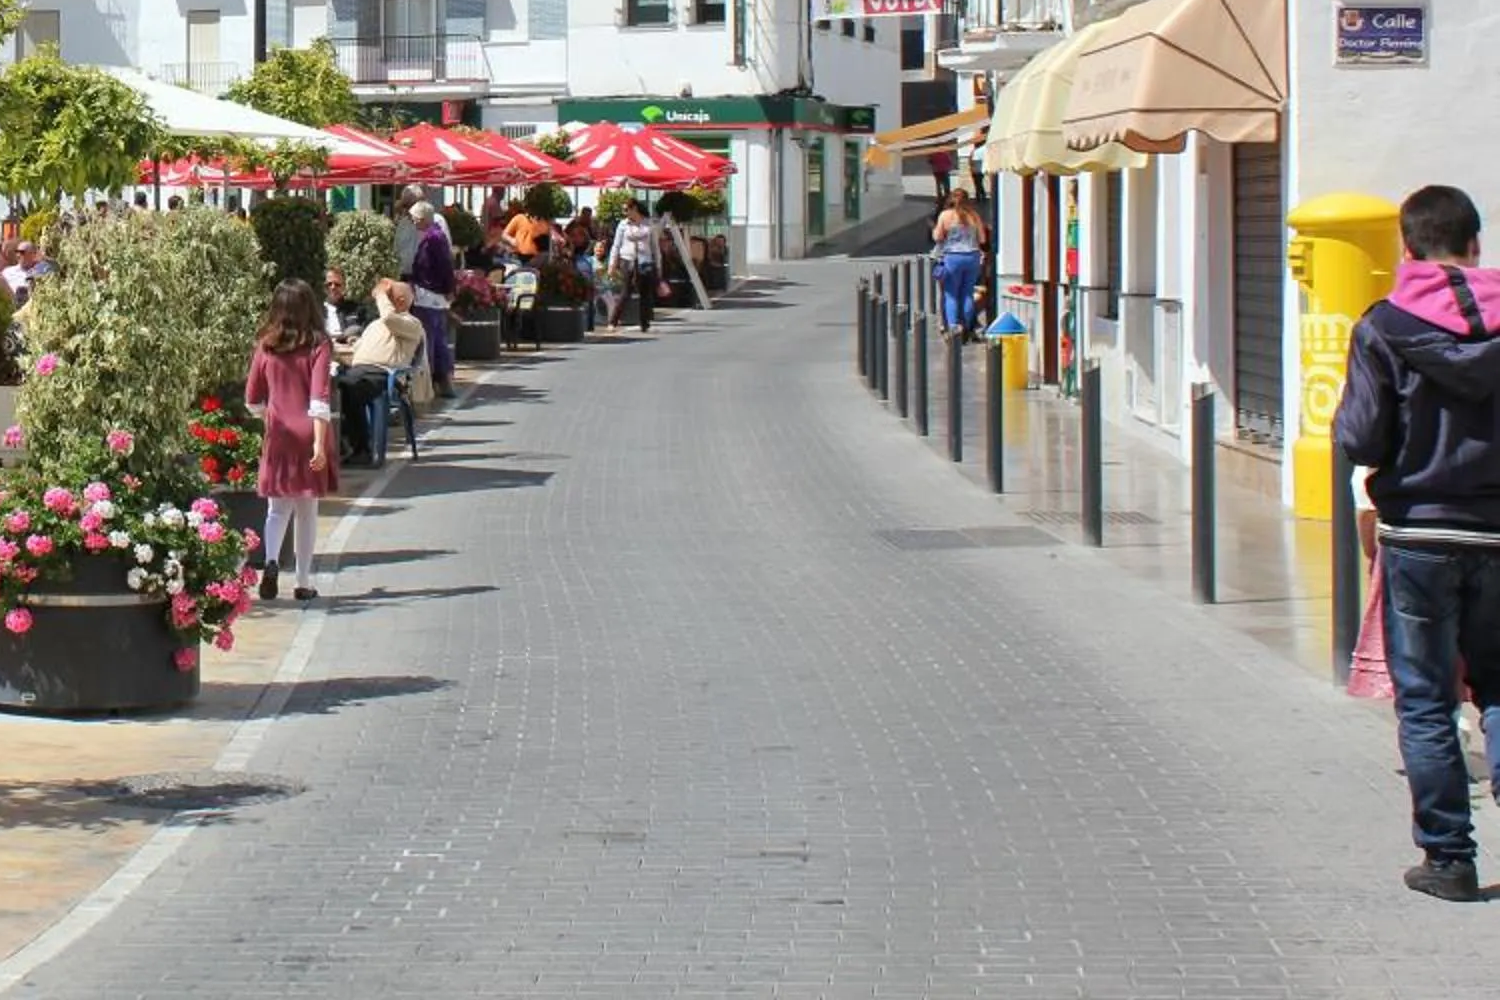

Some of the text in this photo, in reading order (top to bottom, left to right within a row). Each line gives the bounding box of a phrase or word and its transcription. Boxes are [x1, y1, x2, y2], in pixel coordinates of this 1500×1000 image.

[1372, 13, 1417, 29] Calle
[1338, 37, 1377, 49] Doctor
[665, 109, 710, 123] Unicaja
